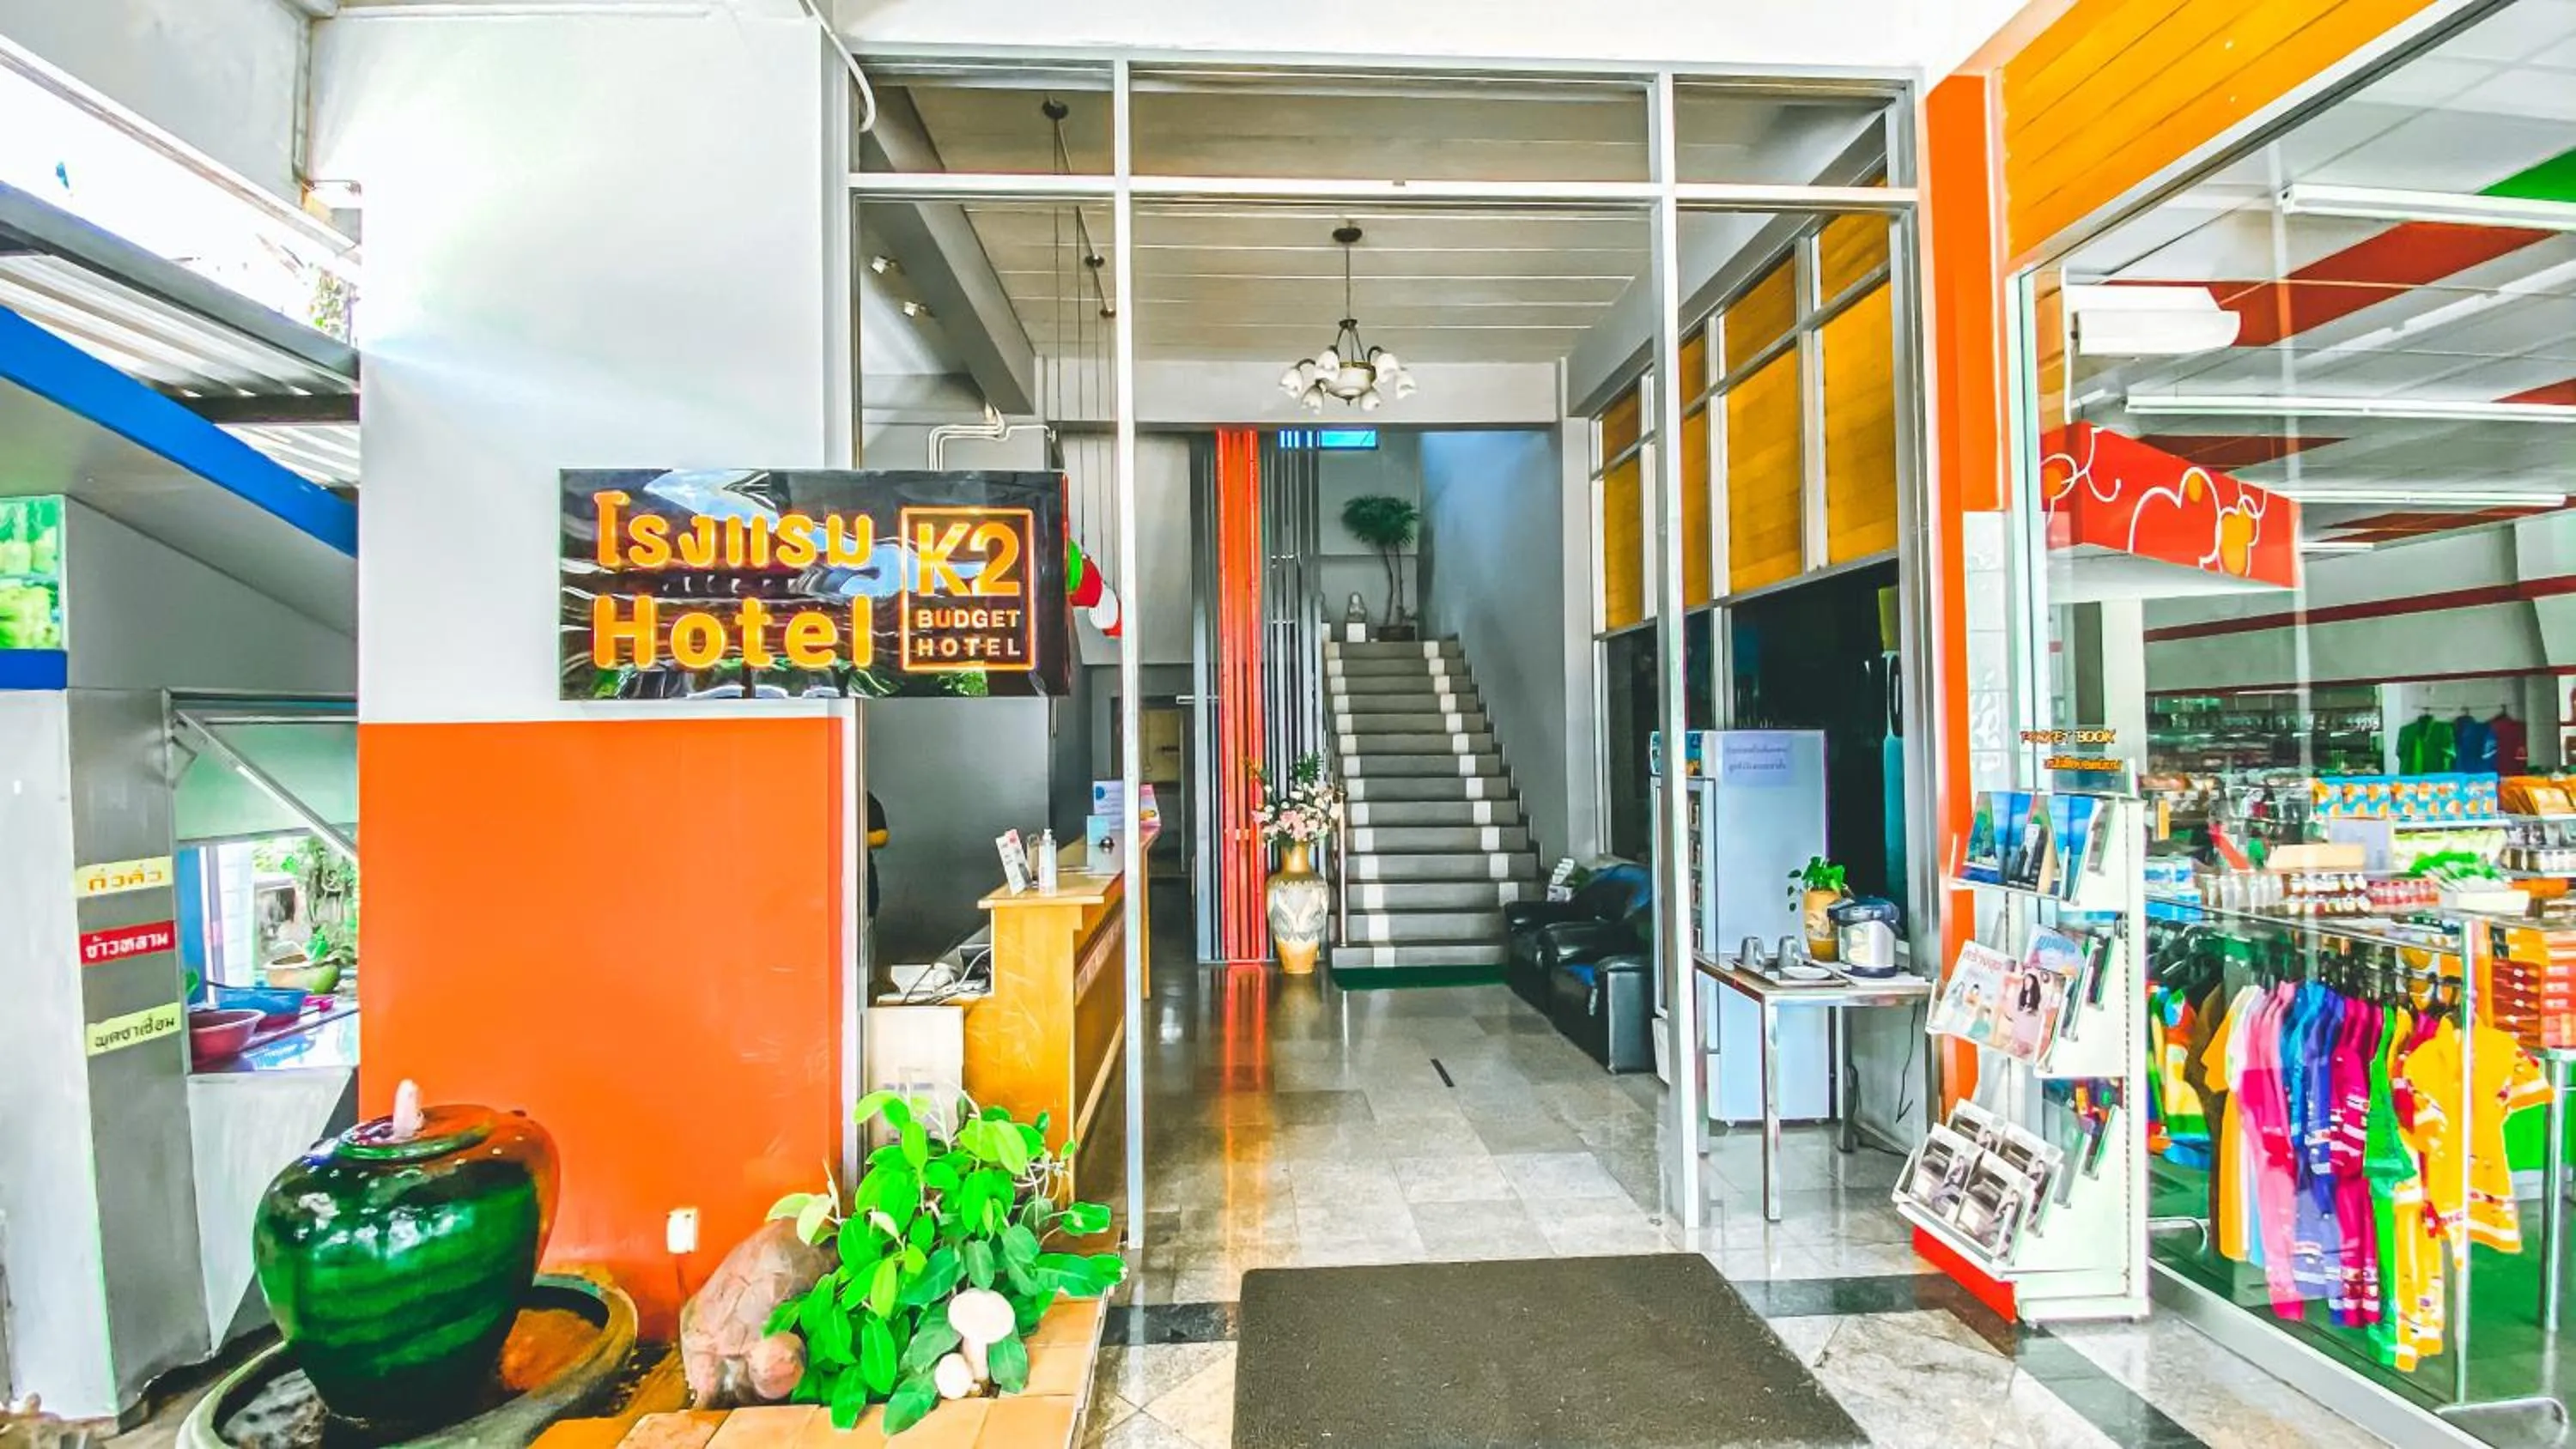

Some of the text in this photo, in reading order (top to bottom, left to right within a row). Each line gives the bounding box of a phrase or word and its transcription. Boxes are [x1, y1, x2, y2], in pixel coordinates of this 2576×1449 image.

[592, 489, 875, 568] โรงแรม
[916, 521, 1020, 597] K2
[592, 594, 874, 669] Hotel
[916, 609, 1020, 629] BUDGET
[916, 637, 1021, 657] HOTEL
[2075, 728, 2116, 744] BOOK
